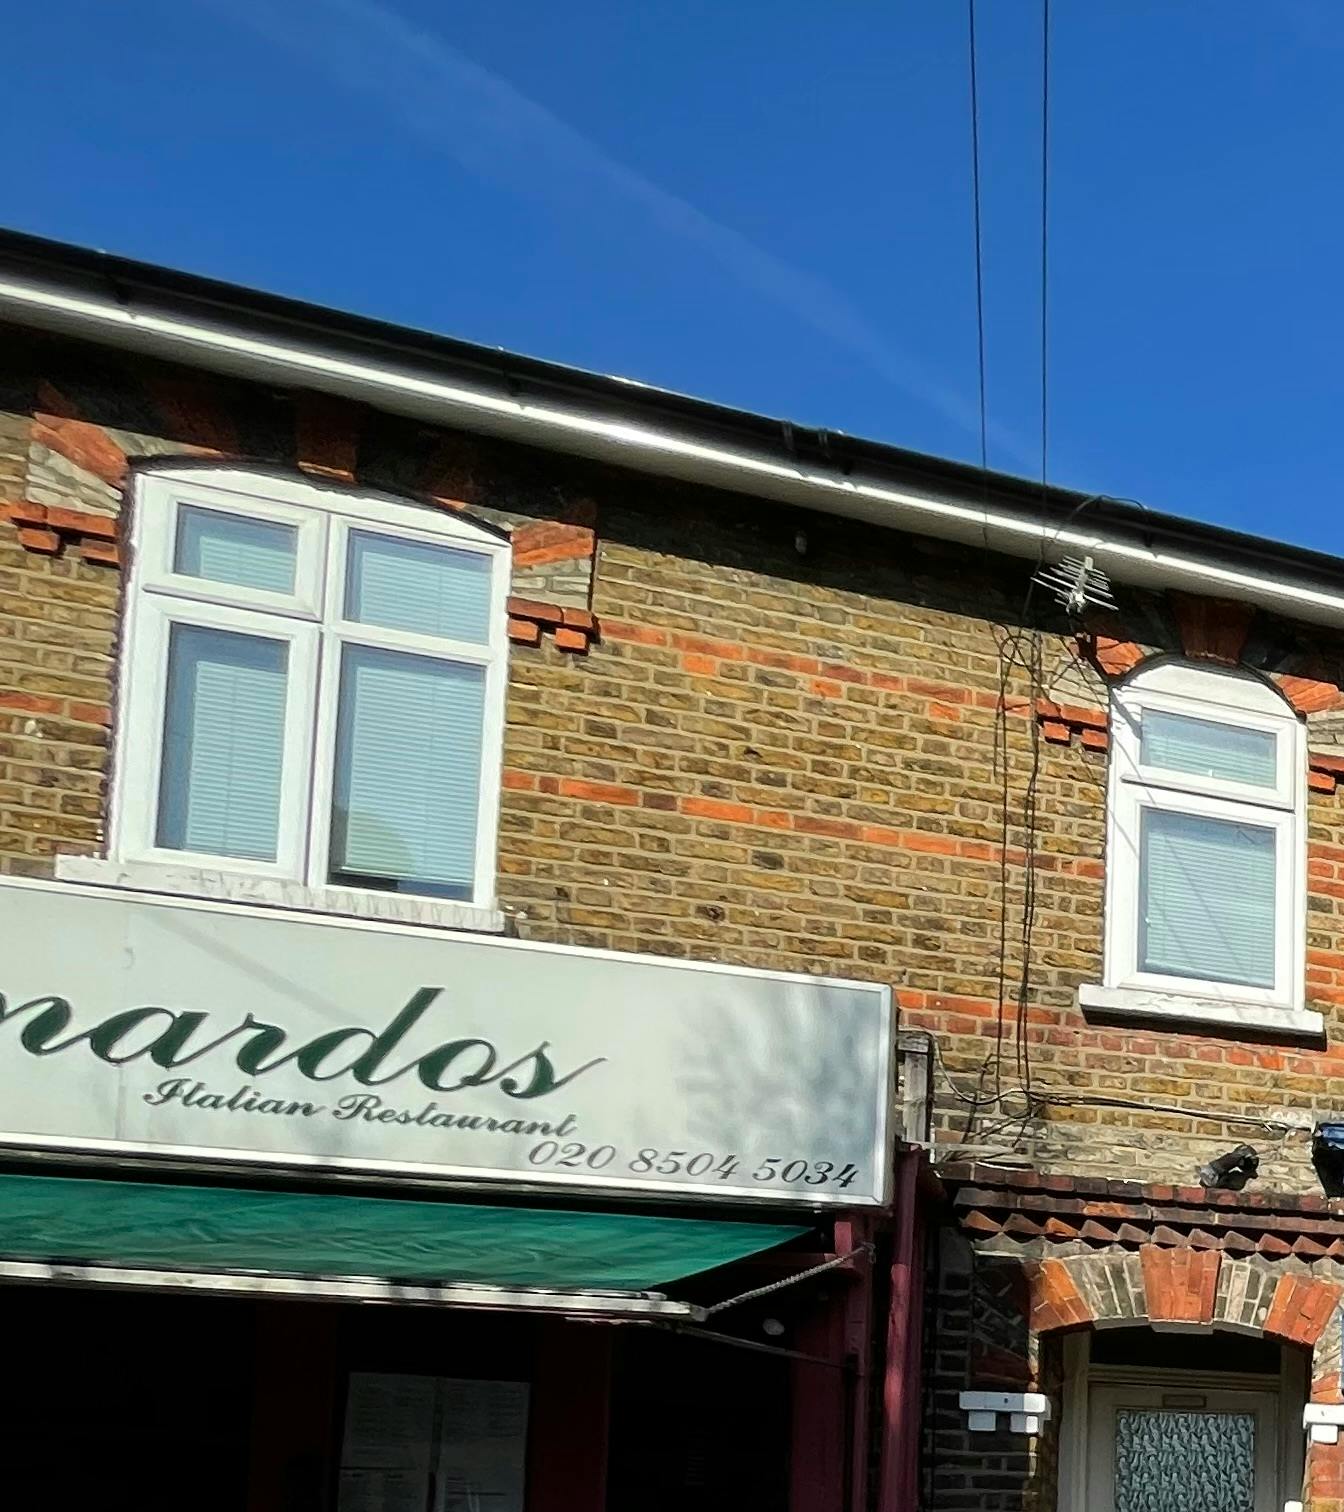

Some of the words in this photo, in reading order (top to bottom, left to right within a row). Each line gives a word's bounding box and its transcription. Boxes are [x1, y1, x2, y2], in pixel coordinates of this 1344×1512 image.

[143, 1078, 322, 1117] Italian
[332, 1093, 577, 1136] Restaurant
[528, 1140, 616, 1170] 020
[628, 1148, 740, 1180] 8504
[752, 1157, 857, 1188] 5034
